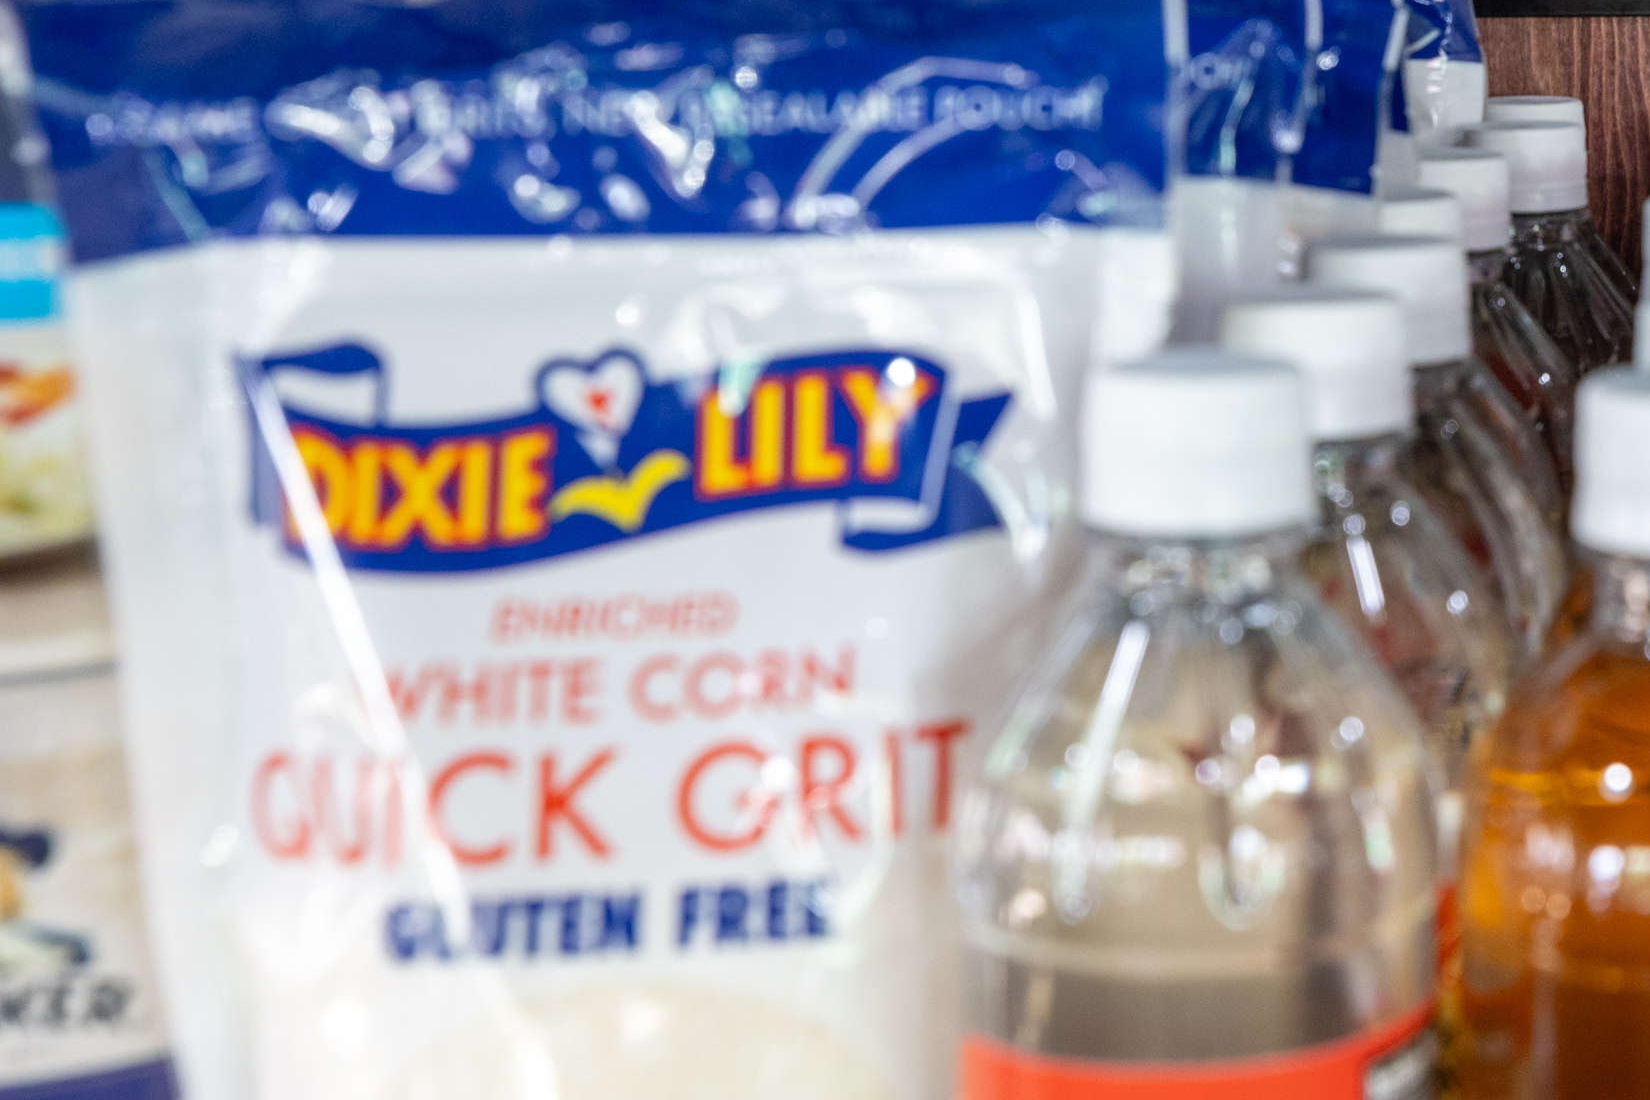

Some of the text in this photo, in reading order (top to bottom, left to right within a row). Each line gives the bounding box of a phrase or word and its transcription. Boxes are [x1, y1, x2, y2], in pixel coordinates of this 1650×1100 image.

[280, 364, 938, 555] DIXIE LILY
[492, 590, 740, 645] ENRICHED
[627, 645, 857, 724] CORN
[250, 746, 622, 872] QUICK
[382, 874, 836, 966] GLUTEN FREE
